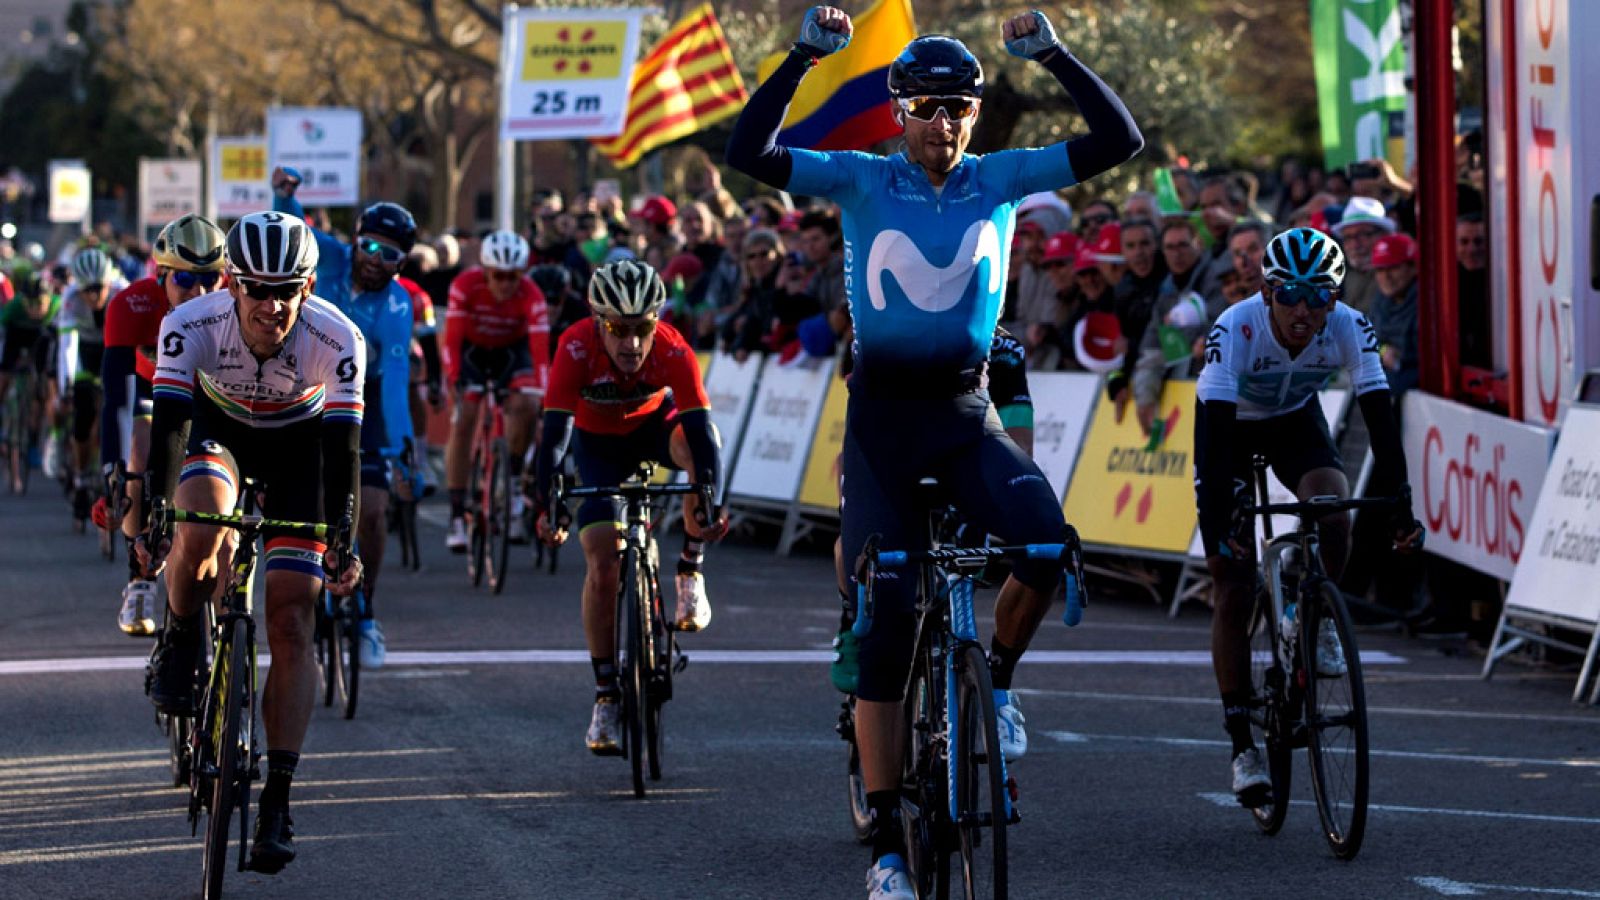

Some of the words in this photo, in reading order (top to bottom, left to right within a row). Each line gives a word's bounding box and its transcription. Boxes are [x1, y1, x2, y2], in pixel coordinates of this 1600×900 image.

[532, 91, 567, 115] 25
[574, 95, 601, 112] m
[300, 316, 345, 353] TCHELTON
[991, 335, 1025, 360] ORA
[1206, 324, 1229, 364] SKY
[1356, 316, 1381, 353] SKY
[1035, 412, 1067, 453] cling
[1106, 446, 1188, 478] CATALUNYA
[1422, 425, 1525, 565] Cofidis
